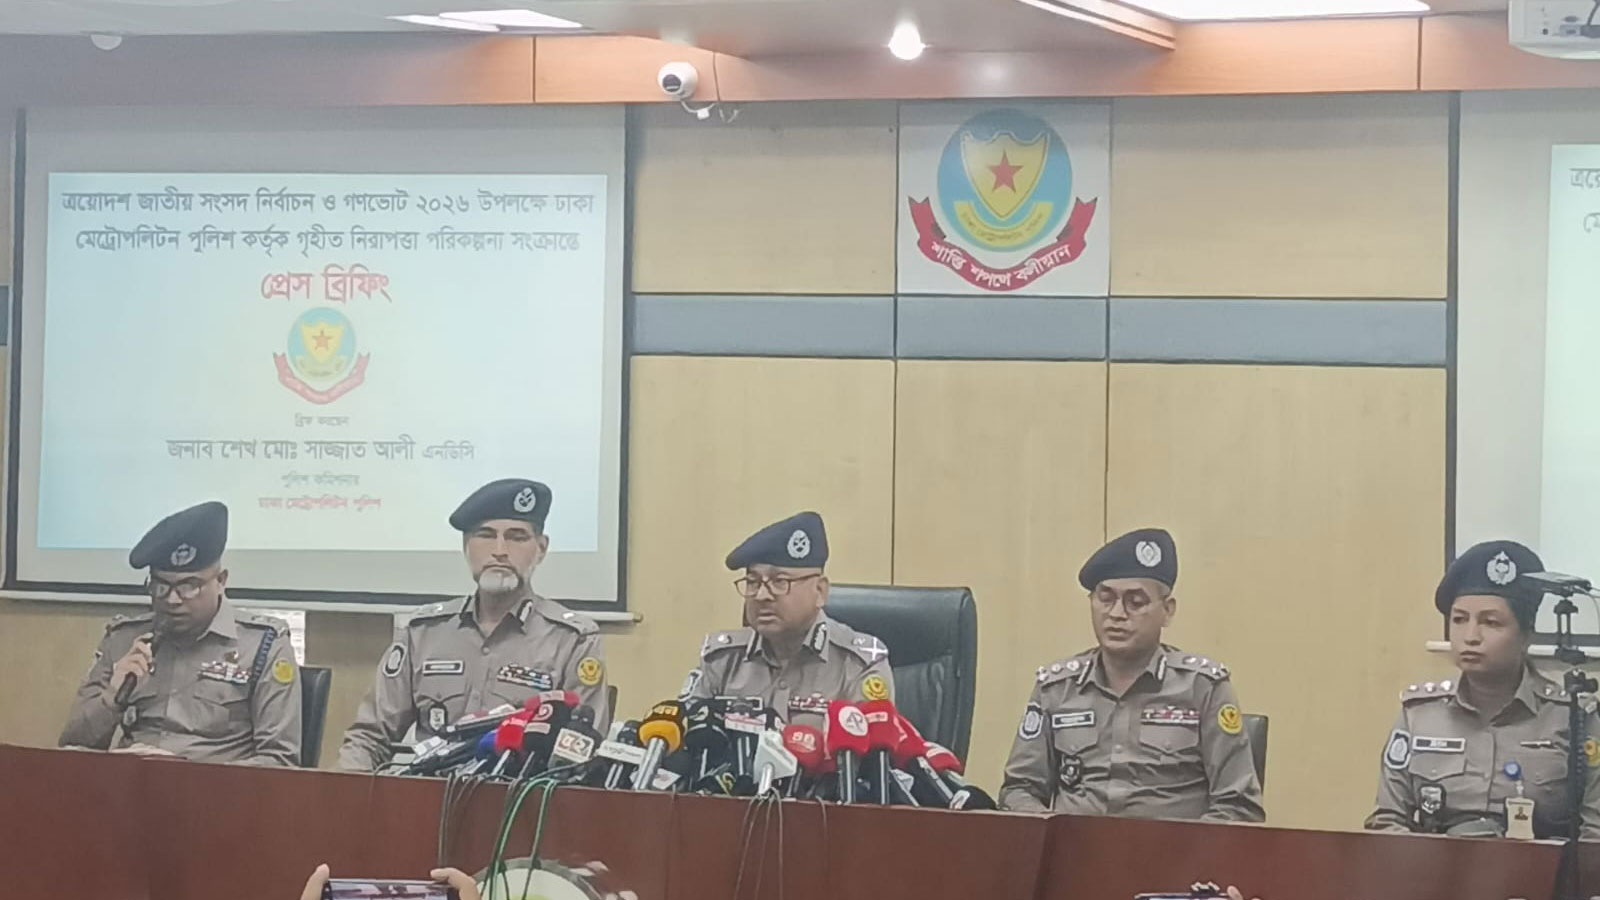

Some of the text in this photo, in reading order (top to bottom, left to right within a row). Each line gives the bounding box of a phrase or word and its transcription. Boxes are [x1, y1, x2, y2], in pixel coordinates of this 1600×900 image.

[62, 186, 594, 214] ত্রয়োদশ জাতীয় সংসদ নির্বাচন ও গণভোট ২০২৬ উপলক্ষে ঢাকা
[76, 224, 181, 251] মেট্রোপলিটন
[188, 224, 237, 253] পুলিশ
[240, 224, 290, 257] কর্তৃক
[297, 223, 344, 258] গৃহীত
[350, 225, 420, 250] নিরাপত্তা
[426, 225, 505, 251] পরিকল্পনা
[261, 264, 391, 301] প্রেস ব্রিফিং
[165, 439, 215, 459] জনাব
[220, 439, 258, 459] শেখ
[261, 440, 297, 459] মোঃ
[372, 434, 416, 460] আলী
[422, 440, 474, 459] এনডিসি
